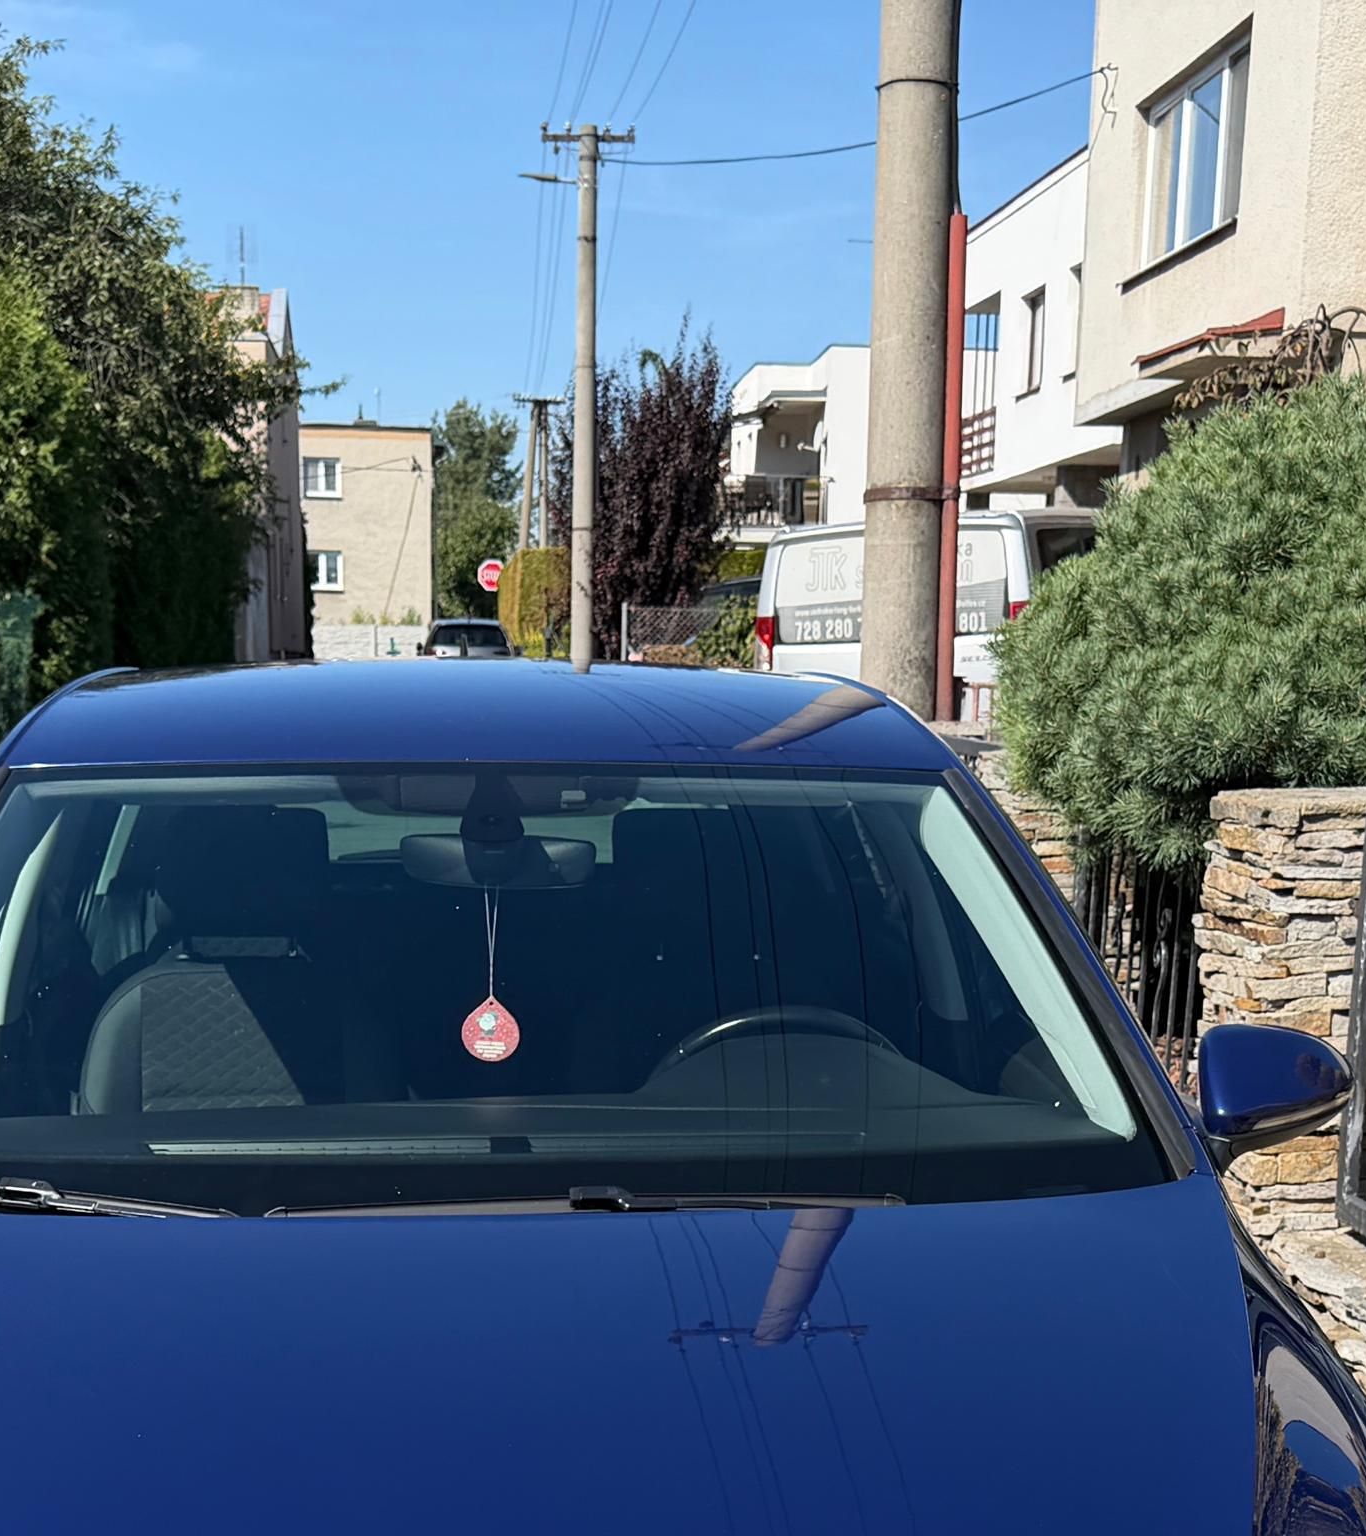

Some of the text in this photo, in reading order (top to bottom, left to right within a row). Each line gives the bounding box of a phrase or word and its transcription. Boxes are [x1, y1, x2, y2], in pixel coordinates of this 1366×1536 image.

[805, 545, 848, 592] JTK
[795, 619, 822, 641] 728
[825, 617, 853, 640] 280
